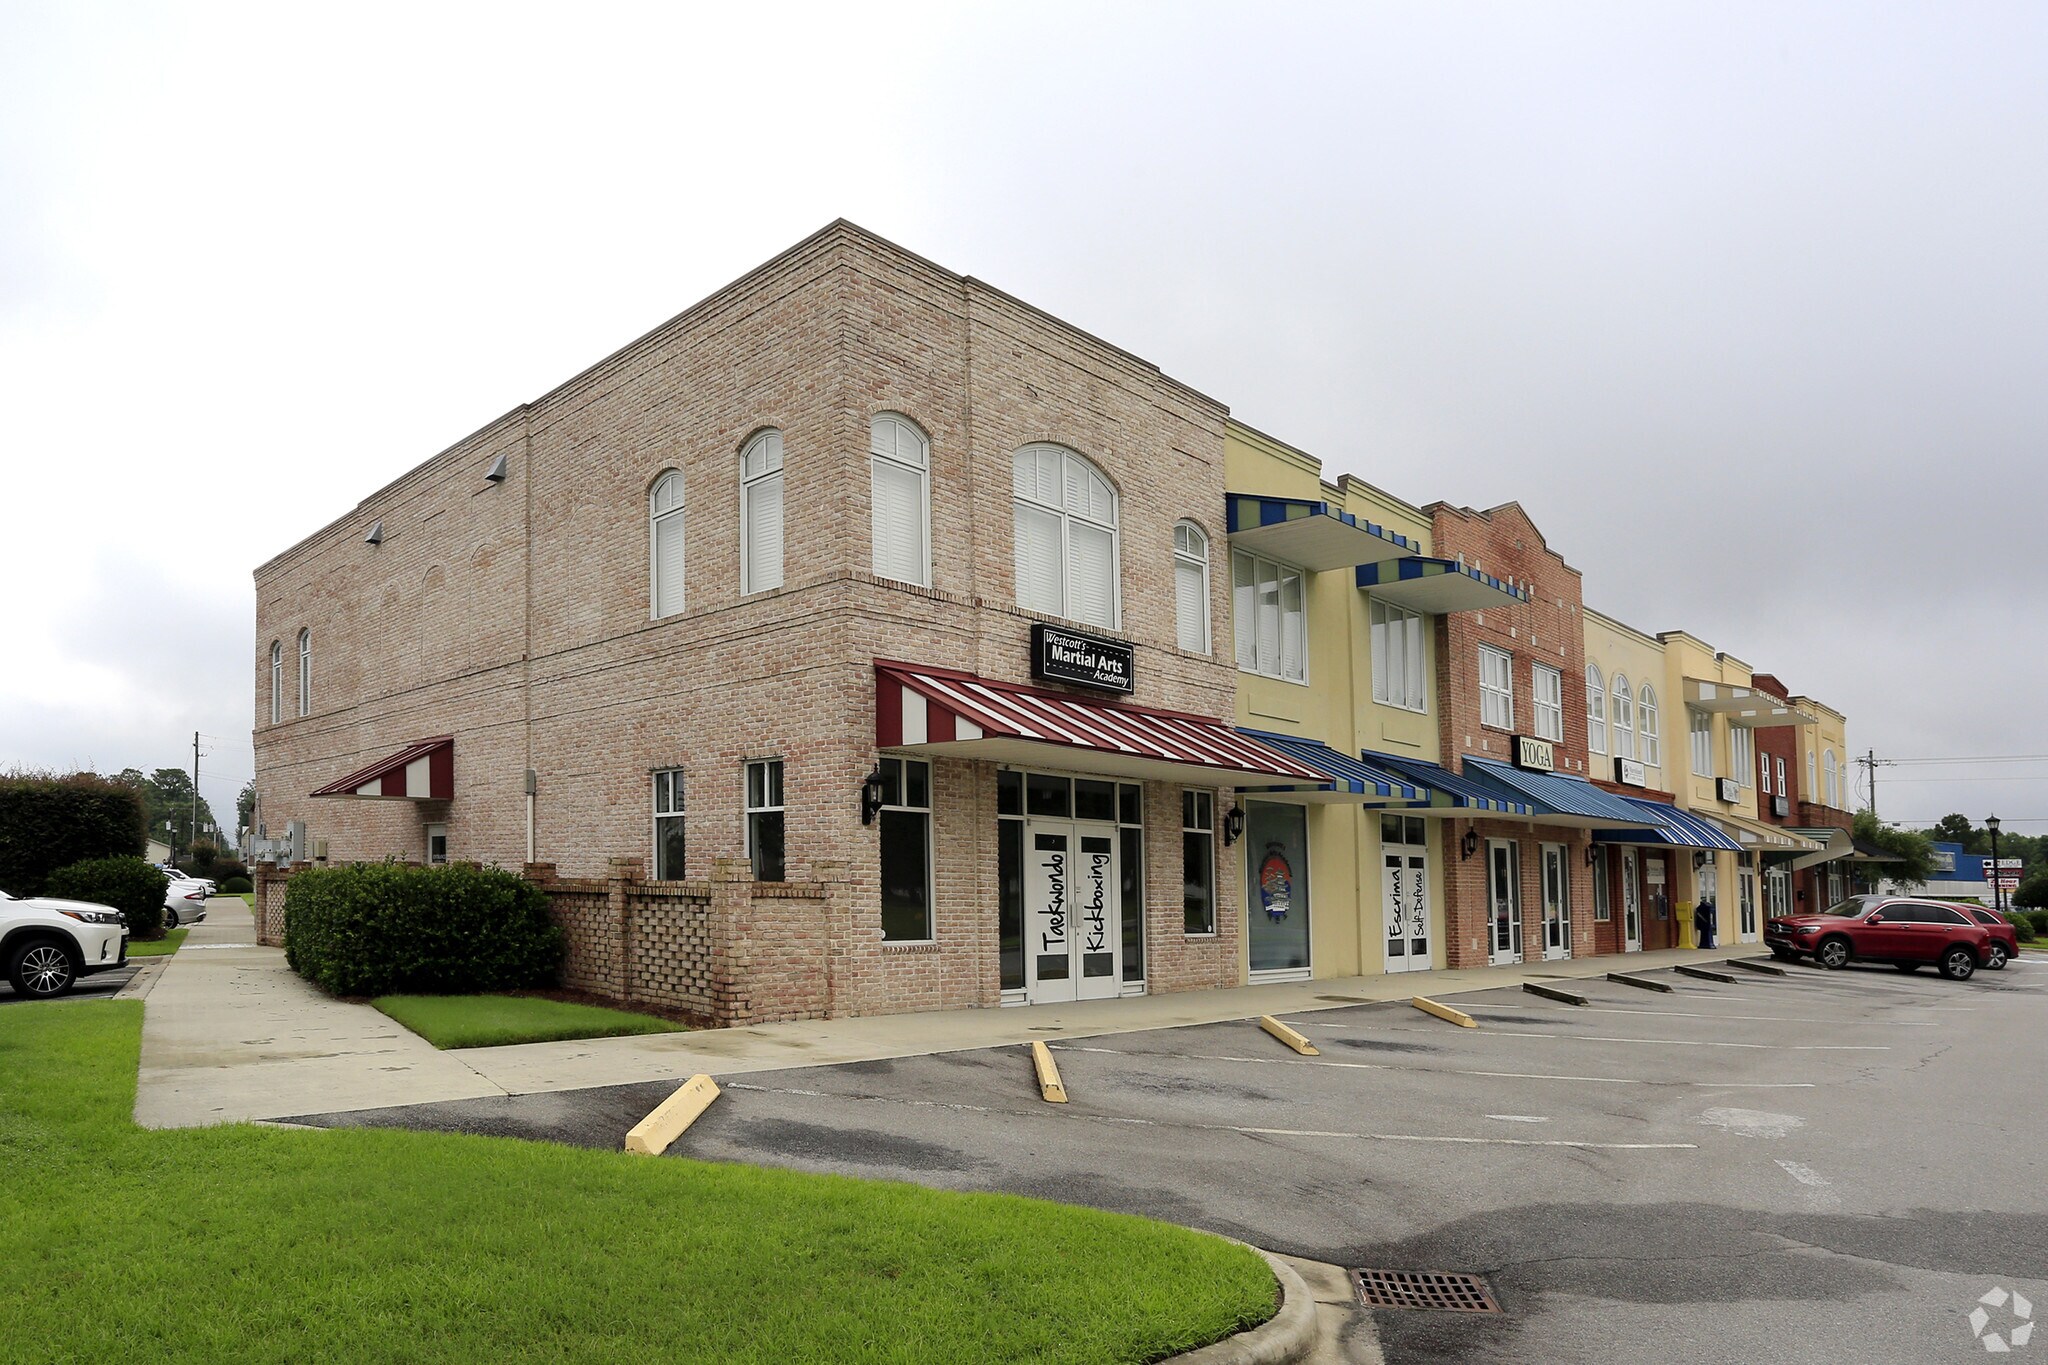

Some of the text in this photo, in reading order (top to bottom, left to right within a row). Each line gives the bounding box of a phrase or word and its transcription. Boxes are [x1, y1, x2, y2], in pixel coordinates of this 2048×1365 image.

[1046, 632, 1087, 651] Westcott's
[1052, 645, 1123, 674] Martial Arts
[1093, 670, 1129, 687] Academy
[1522, 741, 1551, 767] YOGA
[1038, 854, 1065, 951] Taekwondo
[1083, 854, 1109, 952] Kickboxing
[1389, 869, 1402, 937] Escrima
[1412, 871, 1424, 936] Self-Defense
